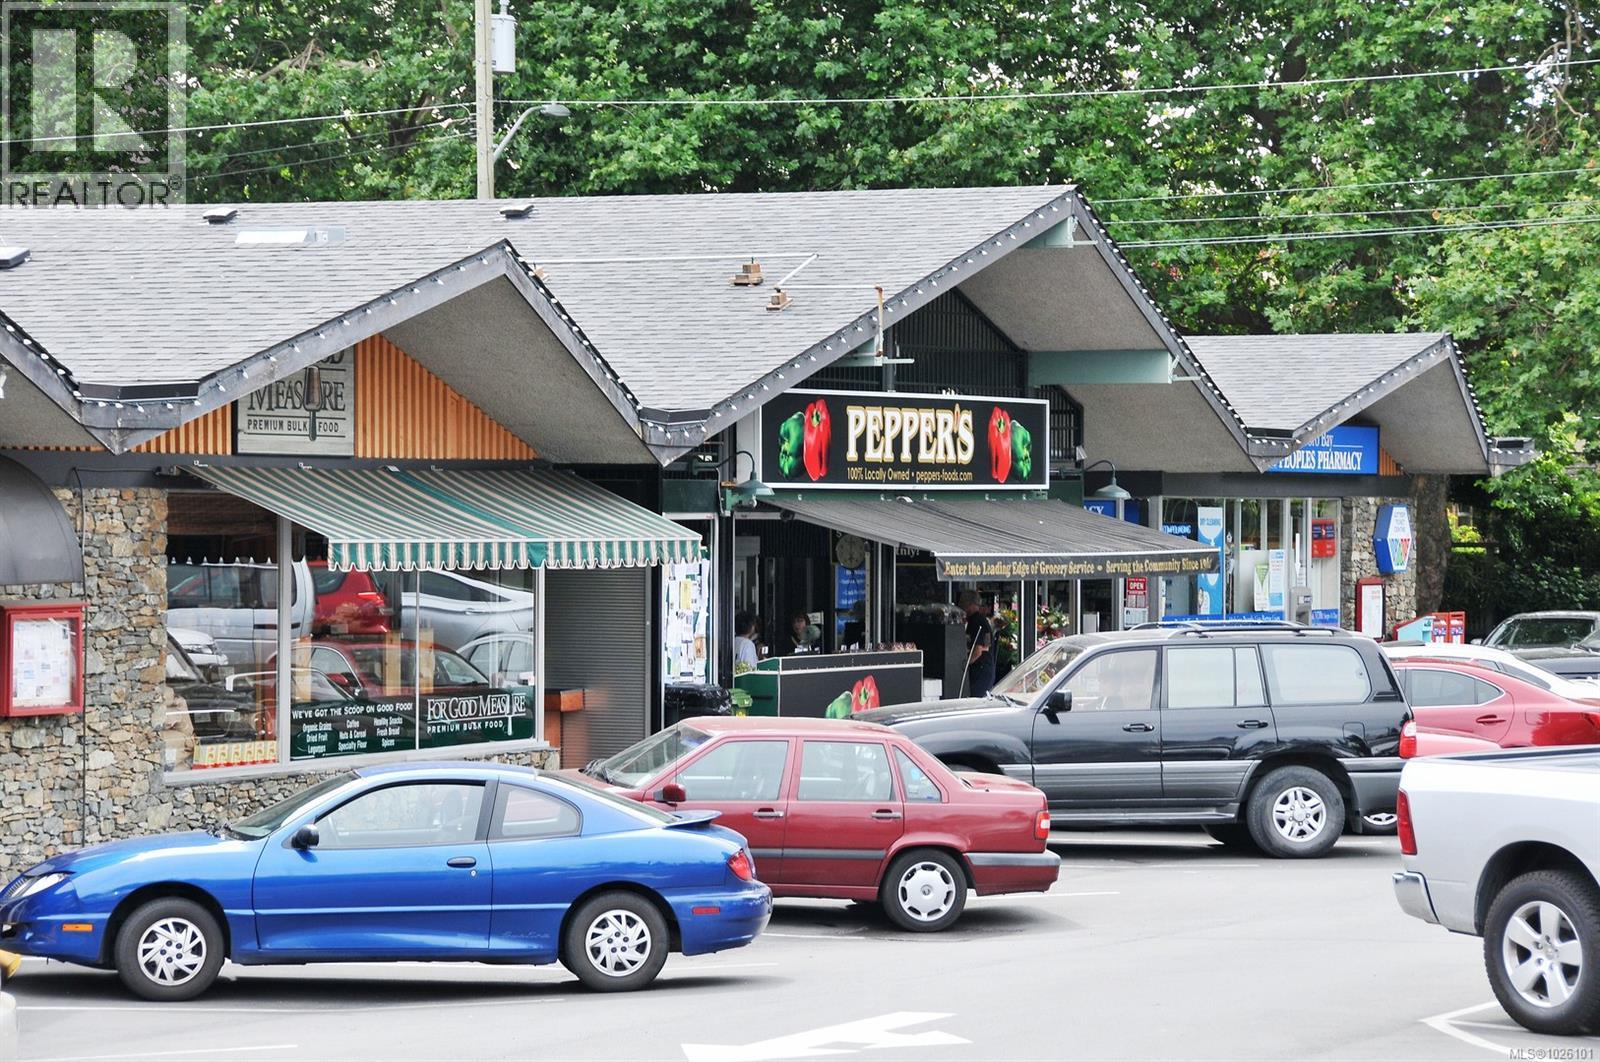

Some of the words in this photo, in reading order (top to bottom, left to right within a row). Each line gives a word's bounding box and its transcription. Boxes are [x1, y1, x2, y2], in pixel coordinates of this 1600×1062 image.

[247, 419, 284, 431] PREMIUM
[287, 421, 308, 432] BULK
[318, 422, 339, 433] FOOD
[846, 403, 975, 465] PEPPER'S
[1318, 451, 1362, 470] PHARMACY
[847, 467, 863, 480] 100%
[865, 467, 885, 482] Locally
[887, 467, 910, 480] Owned
[916, 469, 973, 483] peppers-foods.com
[945, 562, 967, 575] Enter
[968, 561, 980, 575] the
[982, 561, 1011, 577] Leading
[1012, 561, 1029, 577] Edge
[1031, 561, 1039, 574] of
[1040, 561, 1068, 577] Grocery
[1068, 561, 1094, 574] Service
[1106, 560, 1131, 575] Serving
[1133, 560, 1144, 572] the
[1144, 558, 1180, 572] Community
[1182, 557, 1199, 570] Since
[1129, 582, 1144, 590] OPEN
[292, 710, 312, 719] WE'VE
[314, 708, 327, 717] GOT
[330, 708, 341, 716] THE
[344, 706, 364, 715] SCOOP
[366, 705, 374, 713] ON
[377, 704, 393, 712] GOOD
[396, 702, 413, 711] FOOD!
[427, 699, 449, 722] FOR
[449, 697, 477, 718] GOOD
[427, 725, 460, 734] PREMIUM
[485, 720, 503, 729] FOOD
